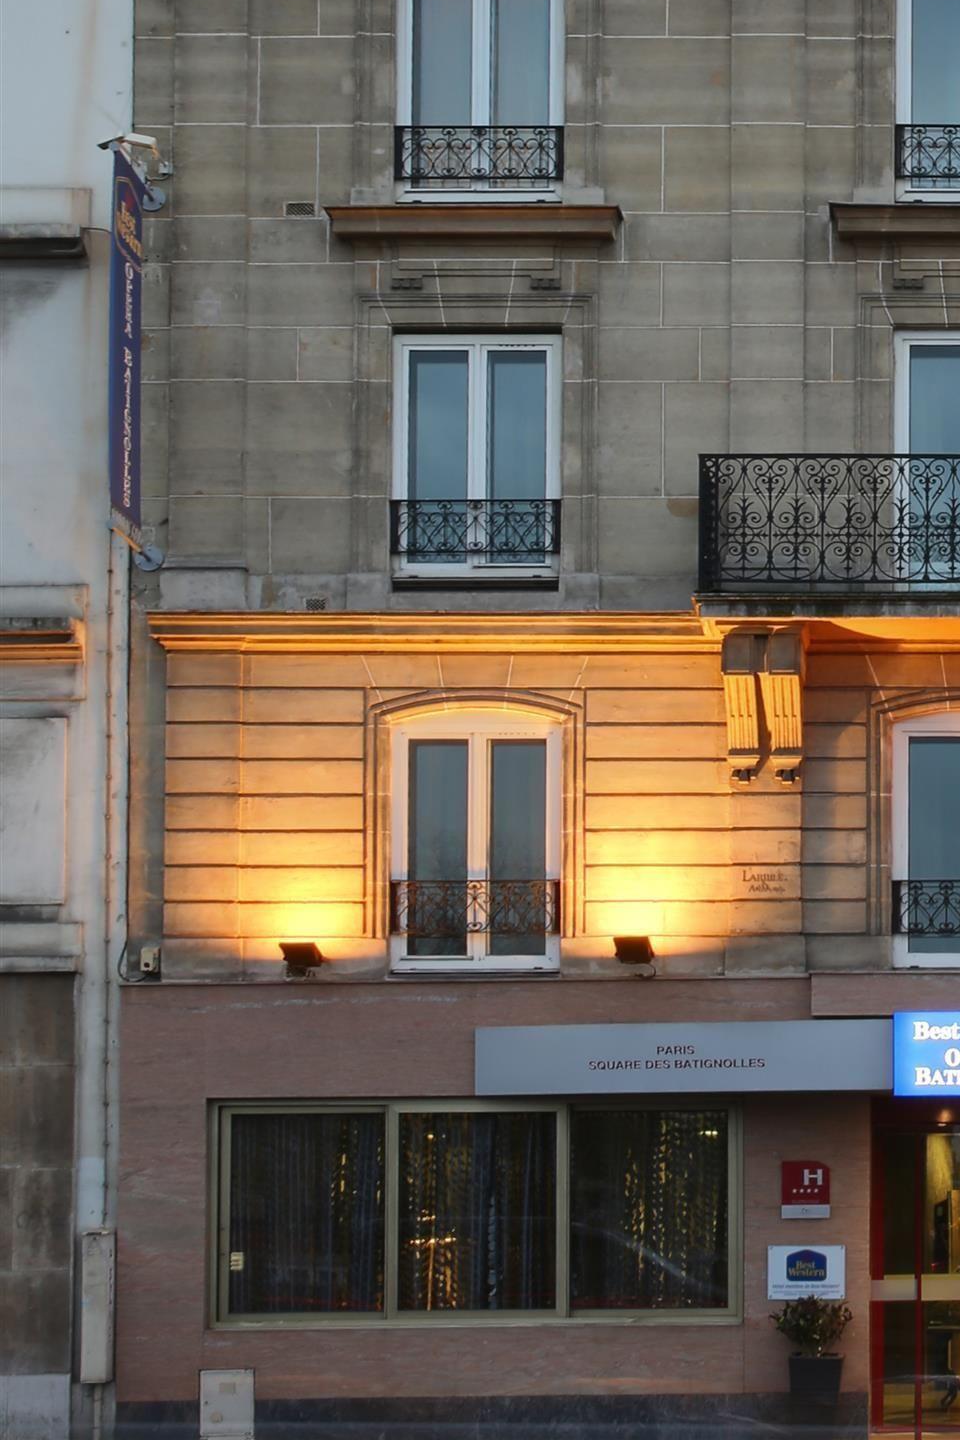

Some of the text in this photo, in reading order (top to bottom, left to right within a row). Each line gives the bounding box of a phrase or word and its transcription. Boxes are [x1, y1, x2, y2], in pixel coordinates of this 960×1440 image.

[912, 1020, 960, 1041] Best
[656, 1045, 695, 1056] PARIS
[588, 1058, 766, 1071] SQUARE DES BATIGNOLLES
[803, 1168, 824, 1186] H
